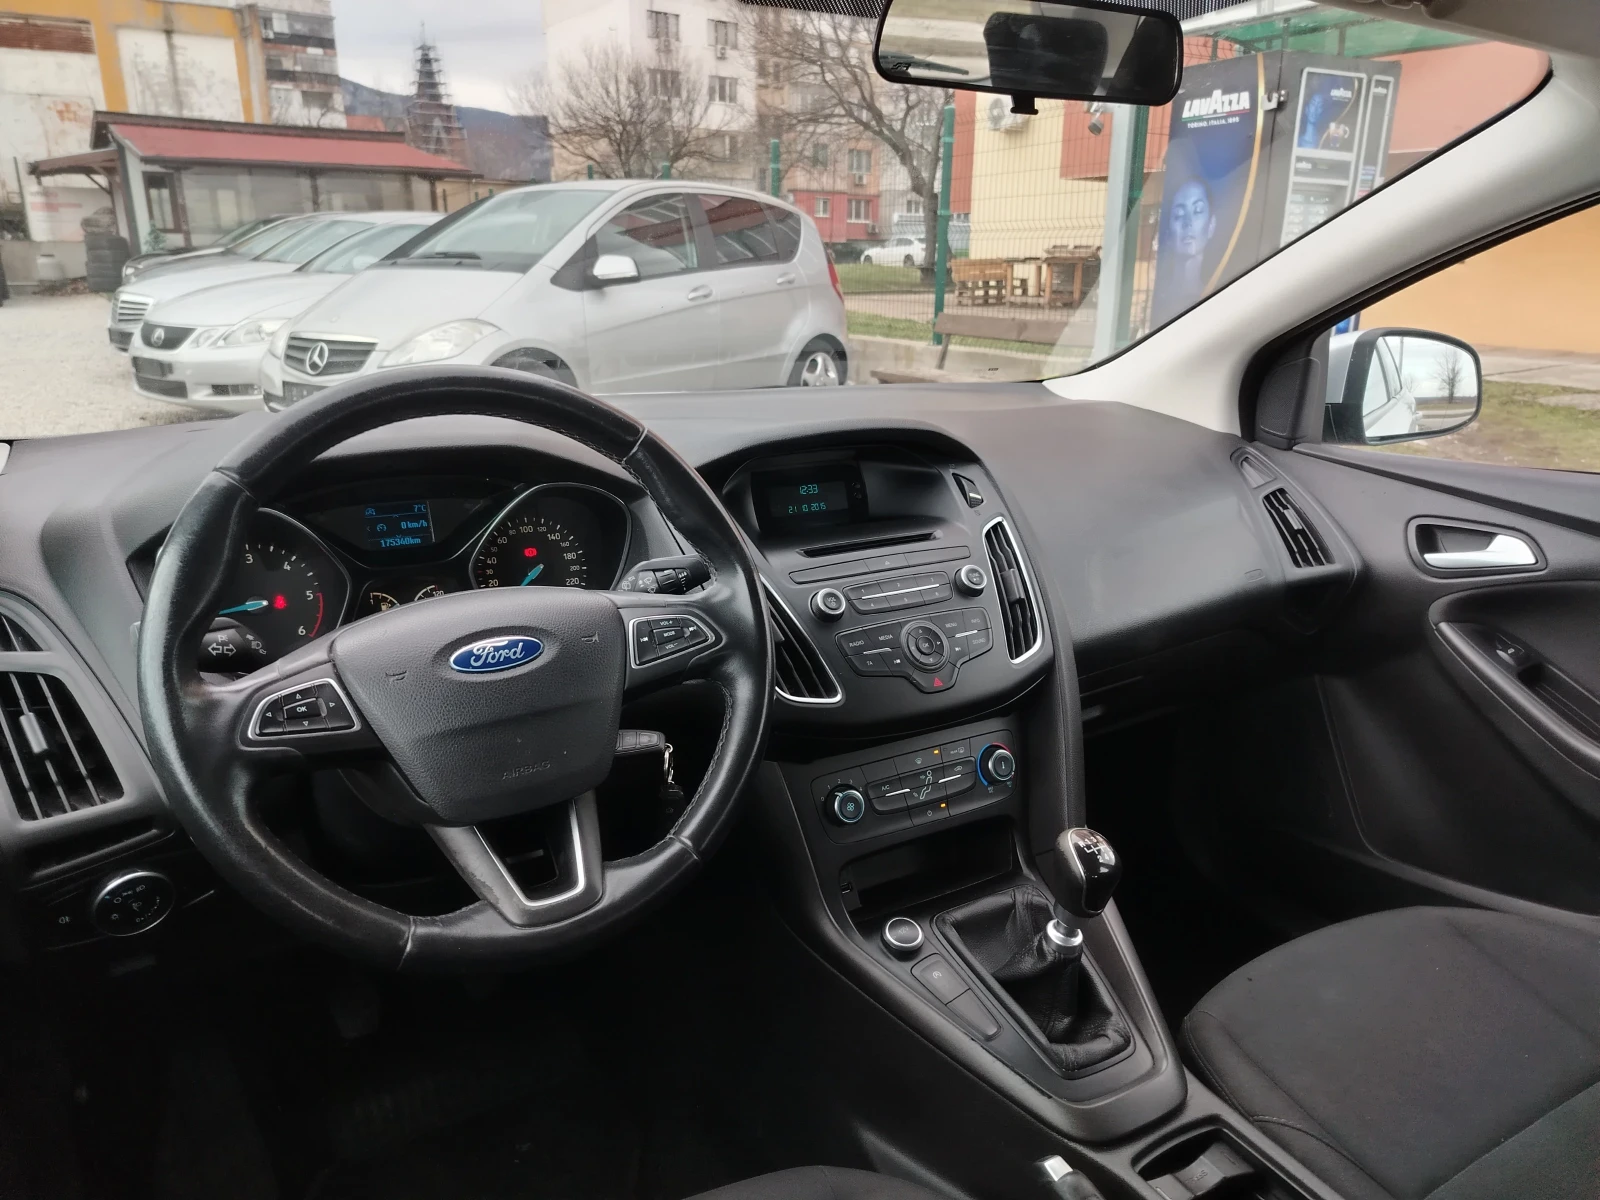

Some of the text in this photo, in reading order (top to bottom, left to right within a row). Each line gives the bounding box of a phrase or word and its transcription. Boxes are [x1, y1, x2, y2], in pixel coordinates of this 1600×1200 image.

[1182, 89, 1250, 118] LAVAZZA
[519, 525, 534, 533] 100
[497, 536, 508, 544] 60
[547, 532, 561, 541] 140
[245, 553, 254, 564] 3
[486, 556, 497, 565] 40
[563, 552, 577, 560] 180
[283, 561, 291, 571] 4
[488, 579, 499, 588] 20
[565, 577, 580, 586] 220
[305, 590, 314, 600] 5
[298, 625, 307, 636] 6
[469, 640, 526, 668] Ford
[296, 705, 308, 713] OK
[502, 760, 551, 780] AIRBAG
[1096, 855, 1104, 863] 2
